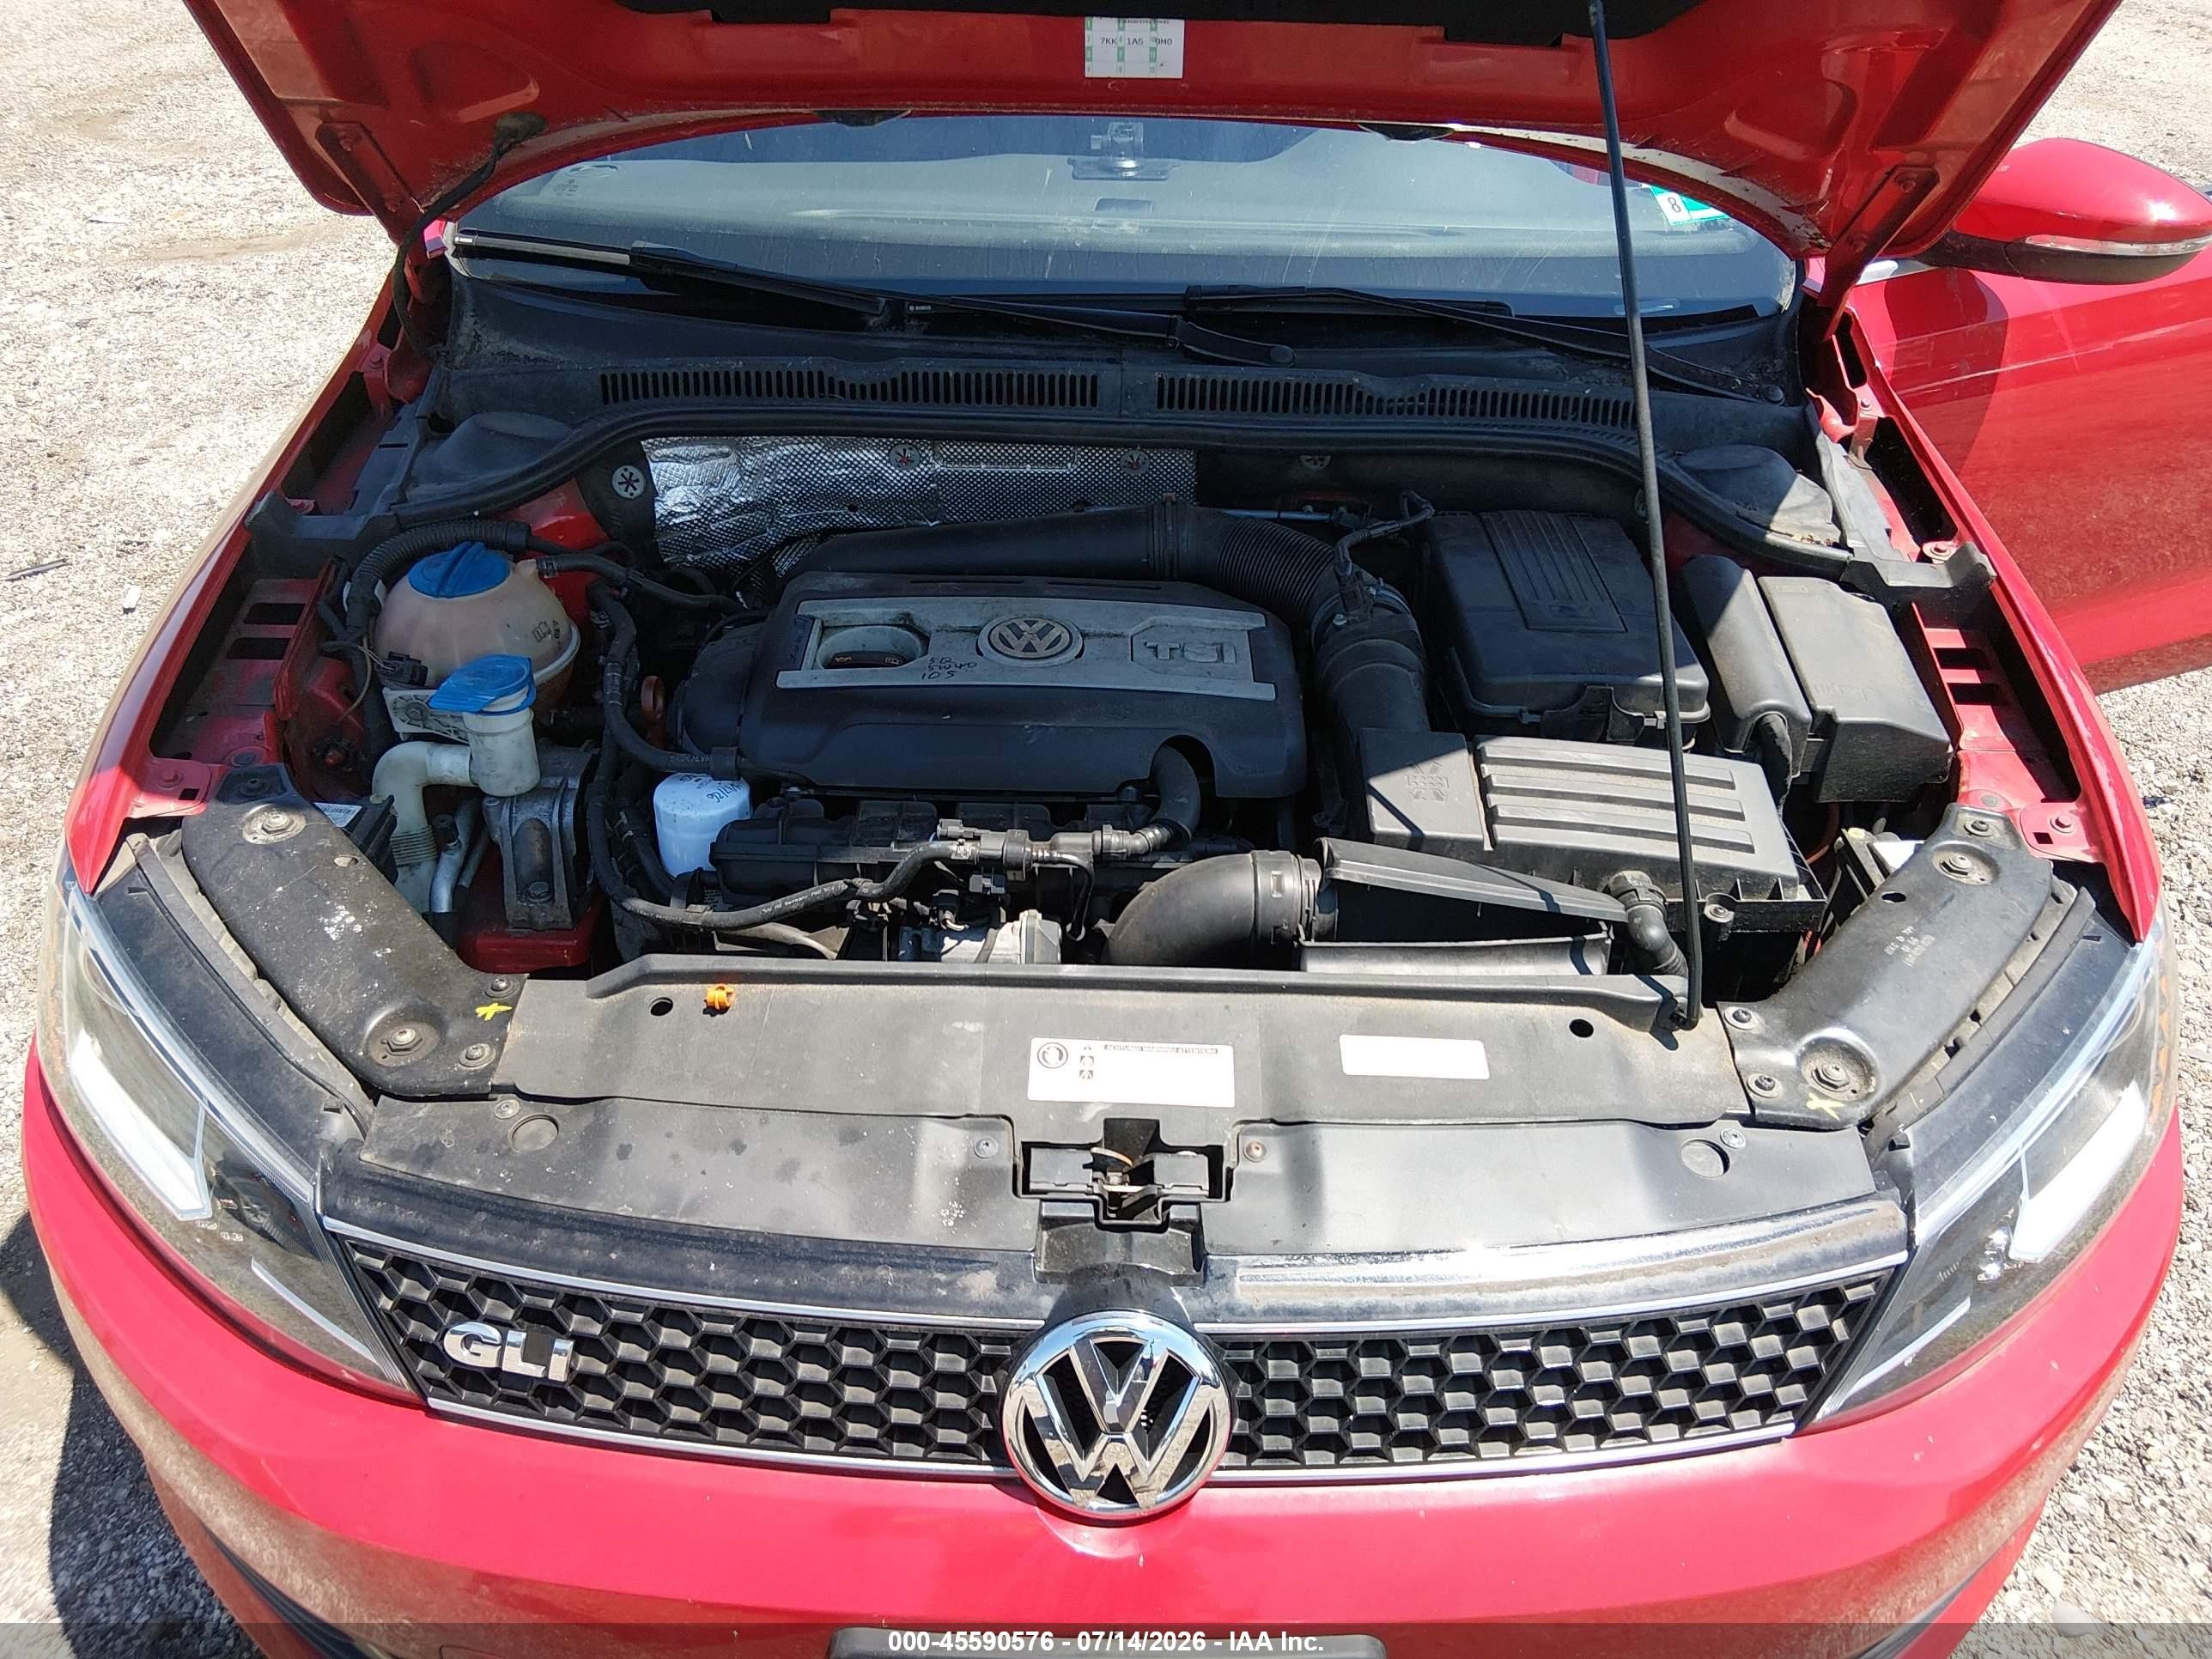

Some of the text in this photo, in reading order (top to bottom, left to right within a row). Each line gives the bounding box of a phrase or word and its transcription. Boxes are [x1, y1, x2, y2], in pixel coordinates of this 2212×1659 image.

[1100, 37, 1117, 46] 7KK
[1668, 197, 1681, 213] 8
[443, 1322, 574, 1382] GLI
